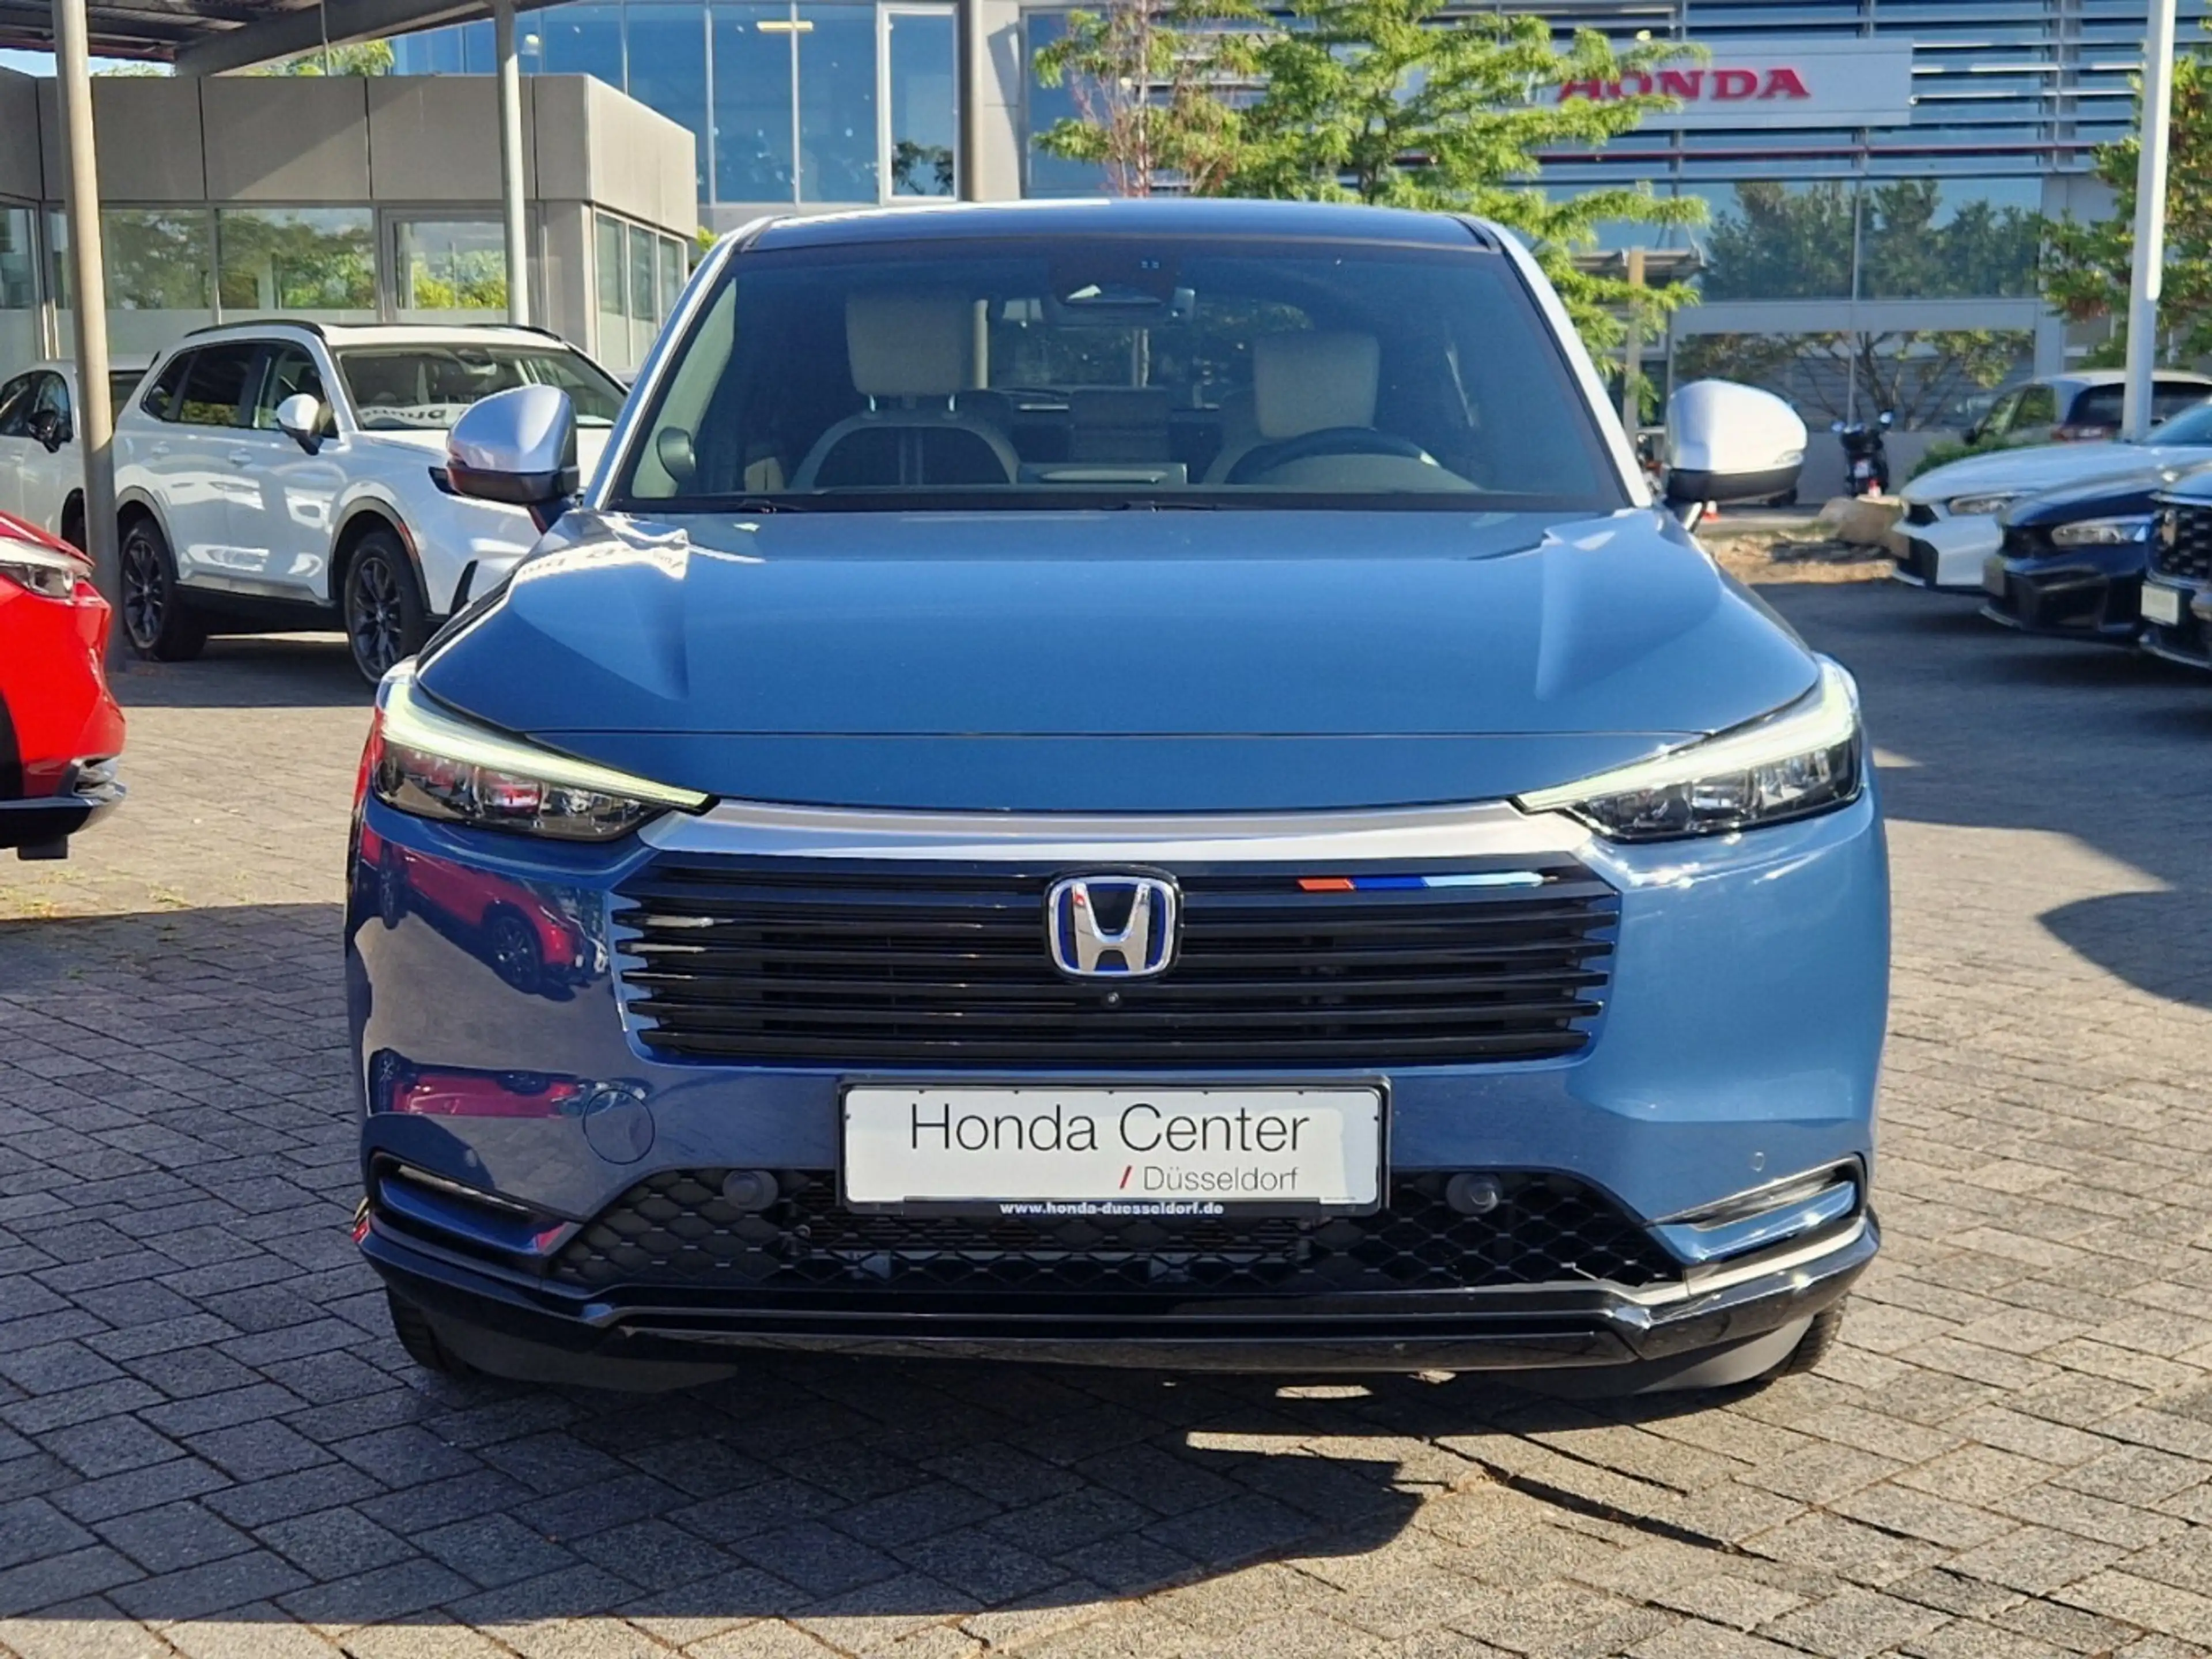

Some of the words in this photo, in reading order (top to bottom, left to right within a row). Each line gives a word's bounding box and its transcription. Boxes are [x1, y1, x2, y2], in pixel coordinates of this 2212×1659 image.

[911, 1103, 1099, 1152] Honda
[1119, 1103, 1311, 1153] Center
[1143, 1165, 1299, 1191] Düsseldorf
[999, 1202, 1224, 1215] www.honda-duesseldorf.de
